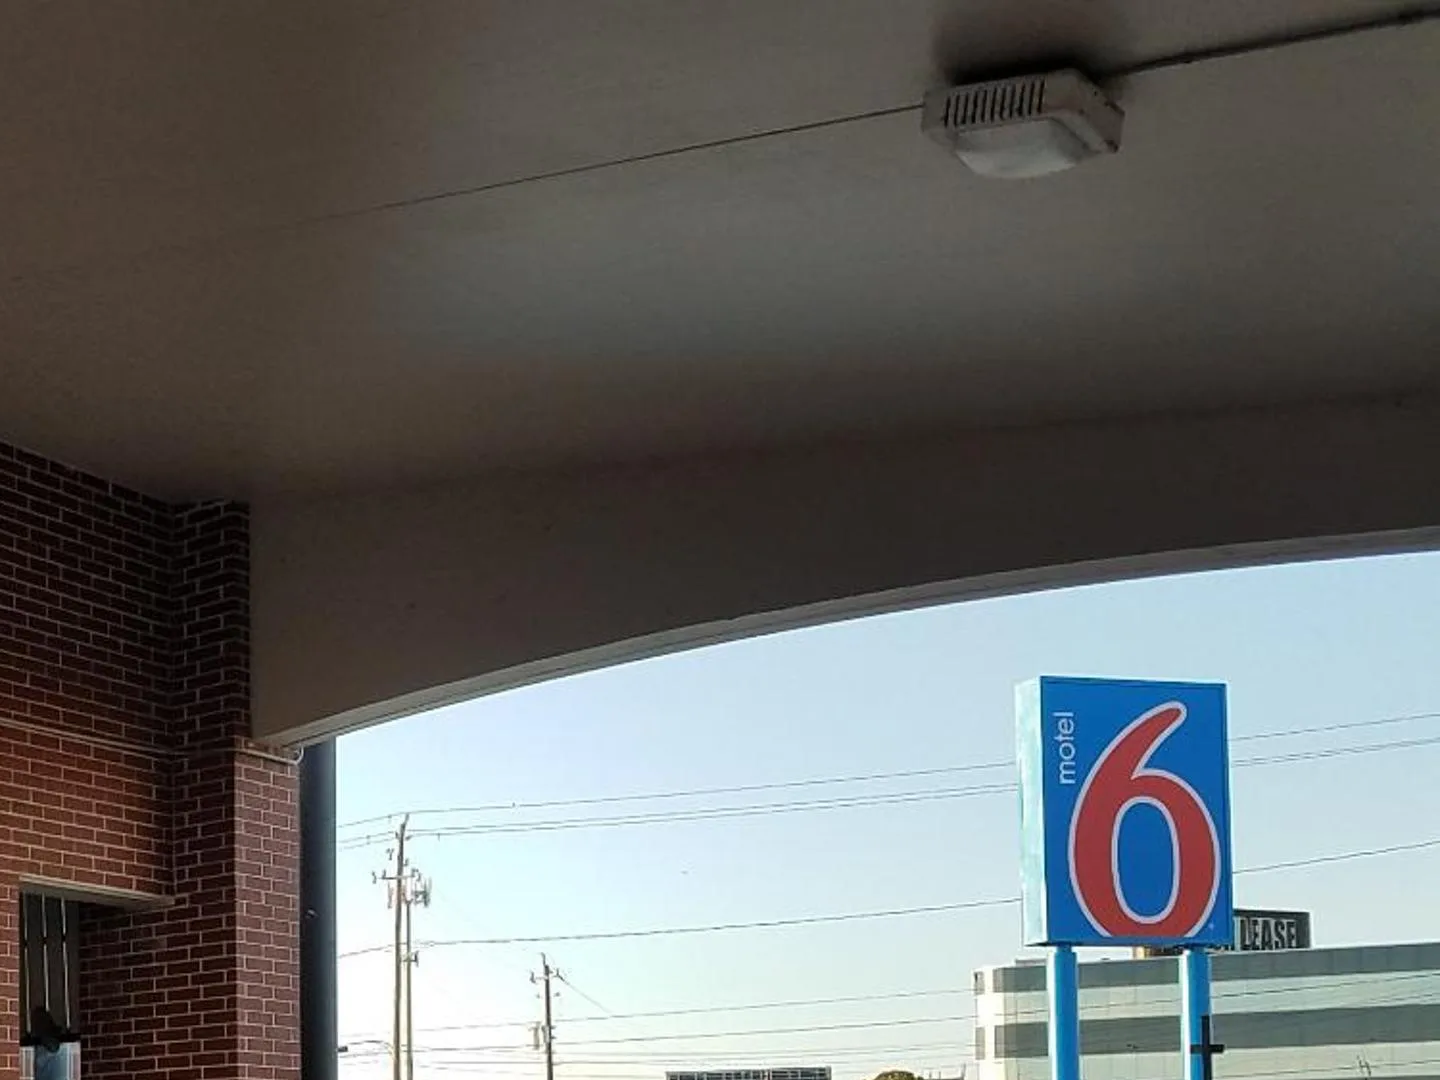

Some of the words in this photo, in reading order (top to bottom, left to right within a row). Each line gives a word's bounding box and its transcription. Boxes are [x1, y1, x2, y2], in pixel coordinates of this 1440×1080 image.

[1053, 711, 1076, 785] motel
[1068, 700, 1221, 938] 6
[1240, 916, 1299, 949] LEASE
